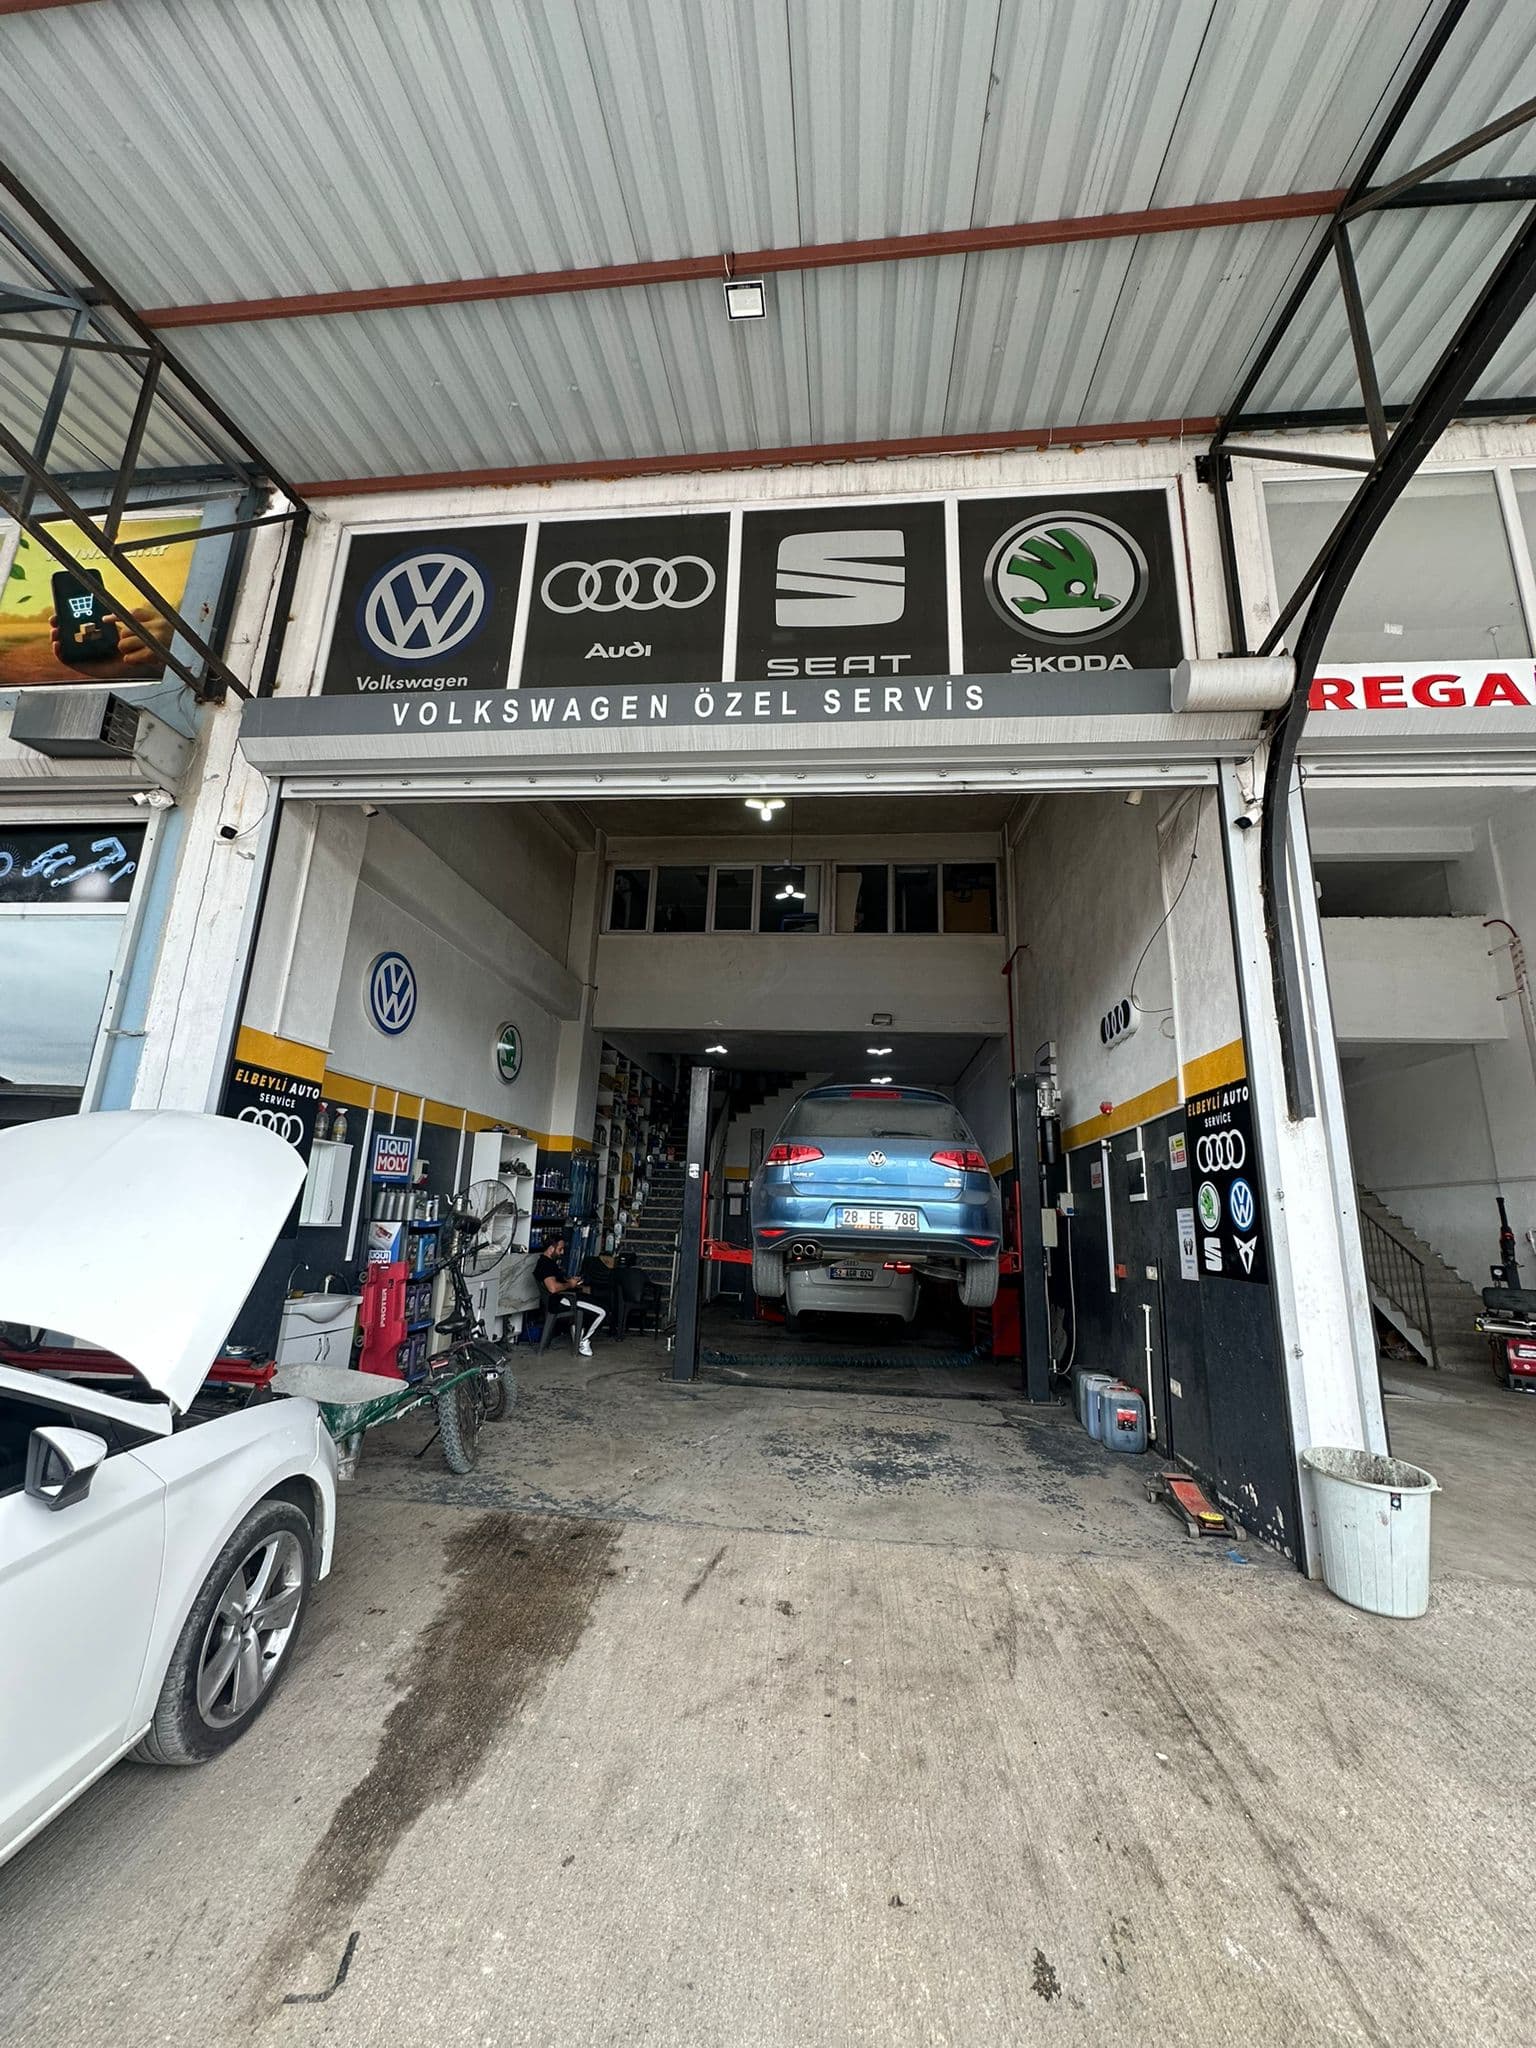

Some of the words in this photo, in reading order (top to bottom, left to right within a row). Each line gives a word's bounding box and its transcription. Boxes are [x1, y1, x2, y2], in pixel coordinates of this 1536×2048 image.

[584, 641, 652, 660] Audi
[767, 655, 912, 678] SEAT
[1010, 652, 1134, 674] ŠKODA
[356, 675, 469, 692] Volkswagen
[392, 694, 669, 727] VOLKSWAGEN
[694, 687, 798, 718] ÖZEL
[823, 682, 984, 714] SERVİS
[235, 1069, 287, 1092] ELBEYLİ
[288, 1083, 320, 1100] AUTO
[259, 1093, 296, 1109] SERVİCE
[1187, 1091, 1220, 1117] ELBEYLİ
[1222, 1086, 1249, 1107] AUTO
[1204, 1112, 1232, 1128] SERVİCE
[379, 1140, 409, 1156] LIQUI
[377, 1156, 407, 1171] MOLY
[844, 1210, 858, 1223] 28
[869, 1211, 883, 1224] EE
[895, 1212, 916, 1226] 788
